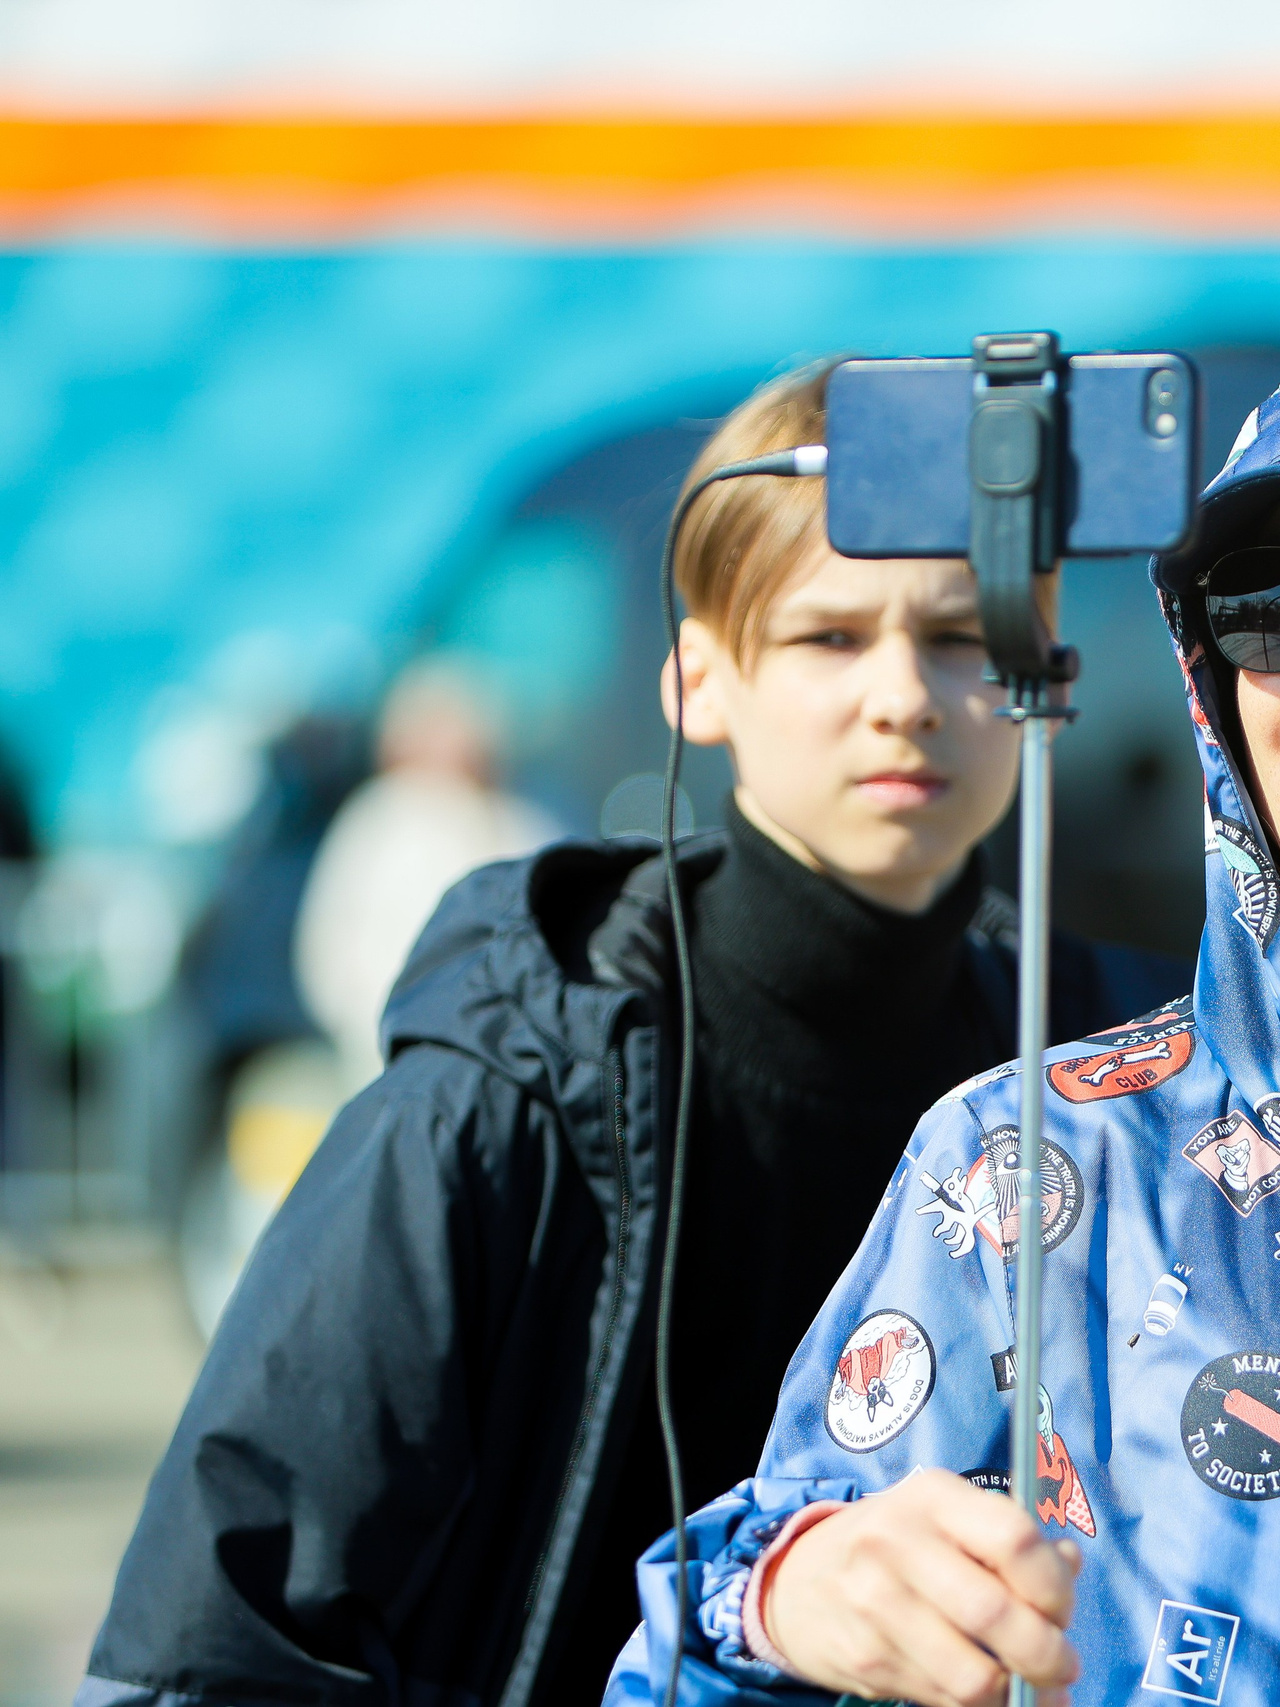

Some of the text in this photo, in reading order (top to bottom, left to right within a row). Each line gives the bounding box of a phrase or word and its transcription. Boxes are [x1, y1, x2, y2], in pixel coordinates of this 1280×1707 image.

[1260, 882, 1278, 936] NOWHERE
[1115, 1068, 1159, 1089] CLUB
[1189, 1118, 1239, 1152] YOU ARE
[1042, 1146, 1077, 1245] THE TRUTH IS NOWHE
[1242, 1185, 1263, 1210] NOT
[835, 1379, 924, 1443] DOG IS ALWAYS WATCHING
[1188, 1428, 1210, 1459] TO
[990, 1475, 1000, 1485] IS
[1166, 1619, 1212, 1686] Ar
